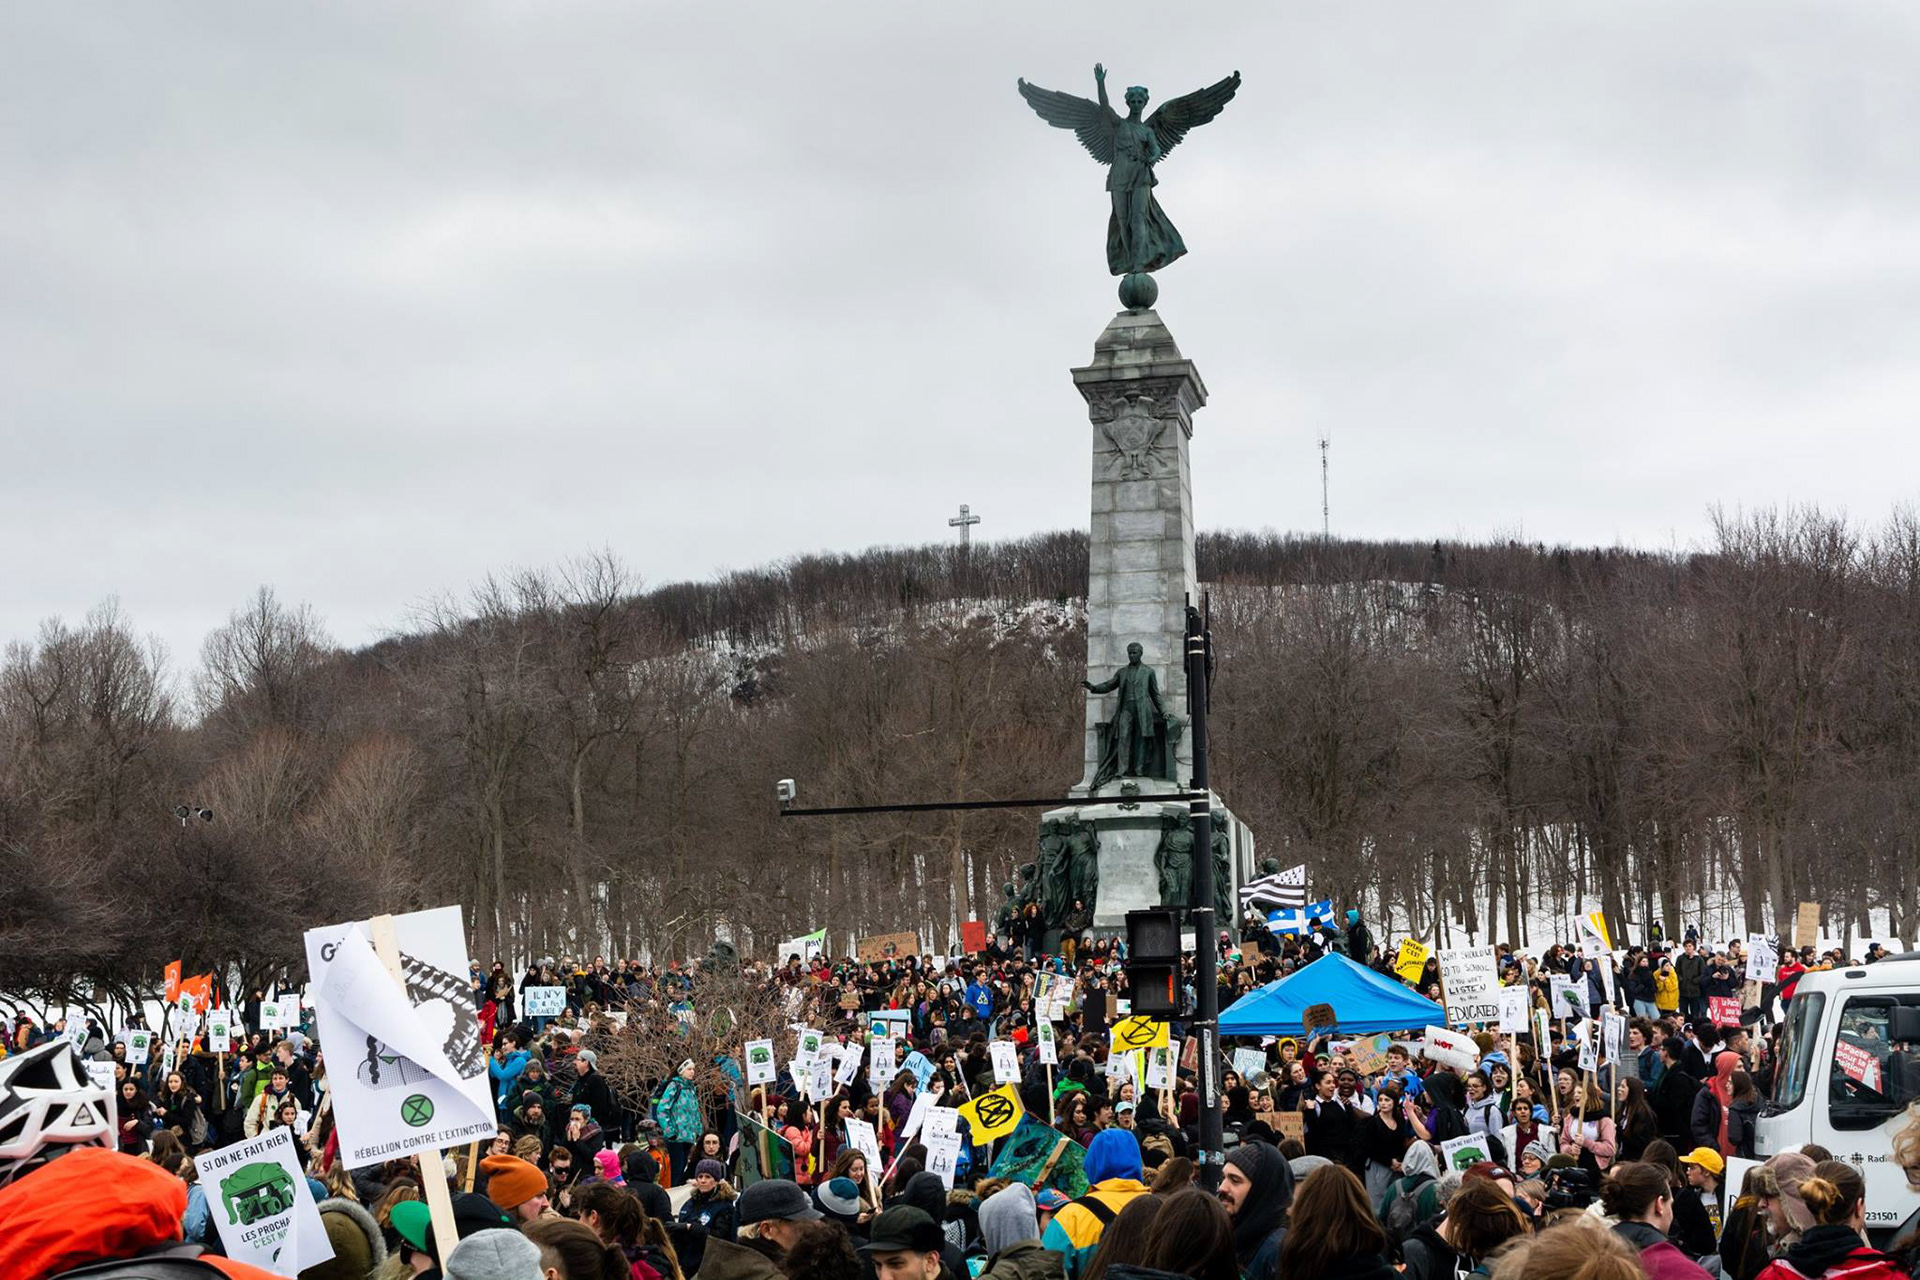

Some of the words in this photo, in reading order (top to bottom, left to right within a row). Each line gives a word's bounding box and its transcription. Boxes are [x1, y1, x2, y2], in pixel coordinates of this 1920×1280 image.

[1440, 951, 1457, 962] WHY
[1451, 965, 1461, 974] TO
[1448, 984, 1487, 996] LISTEN
[1434, 1038, 1454, 1050] NOT
[1836, 1051, 1858, 1063] pour
[1843, 1043, 1869, 1060] Pacte
[354, 1140, 402, 1160] RÉBELLION
[403, 1132, 437, 1149] CONTRE
[439, 1121, 493, 1141] L'EXTINCTION
[202, 1160, 213, 1172] SI
[215, 1156, 229, 1169] ON
[230, 1151, 244, 1164] NE
[244, 1142, 265, 1158] FAIT
[267, 1132, 289, 1151] RIEN
[1833, 1155, 1846, 1163] BC
[1865, 1211, 1898, 1221] 231501
[241, 1230, 257, 1243] LES
[257, 1215, 292, 1238] PROCHA
[253, 1234, 275, 1249] C'EST
